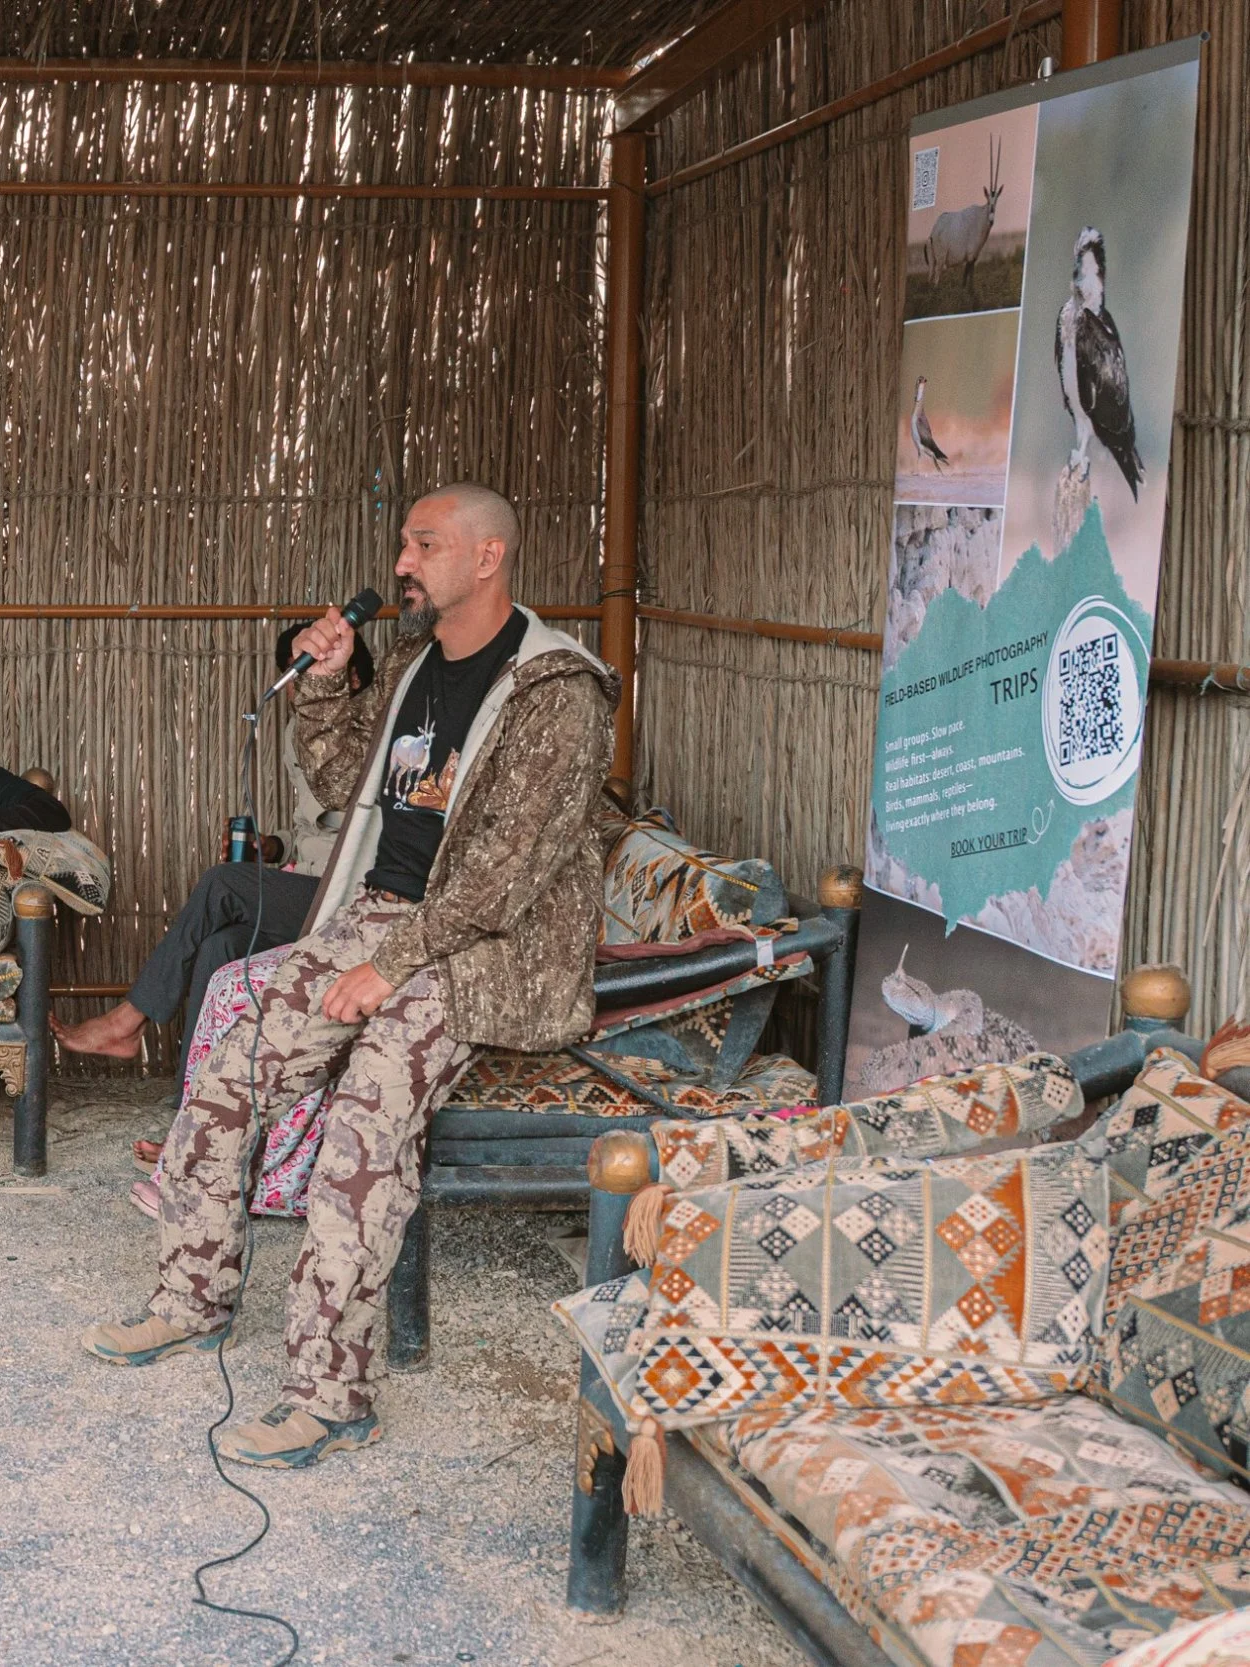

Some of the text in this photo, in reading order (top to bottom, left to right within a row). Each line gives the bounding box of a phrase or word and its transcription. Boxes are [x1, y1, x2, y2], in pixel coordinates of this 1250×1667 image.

[884, 630, 1049, 707] FIELD-BASED WILDLIFE PHOTOGRAPHY
[990, 667, 1038, 705] TRIPS
[885, 736, 903, 754] Small
[931, 726, 947, 740] Slow
[885, 777, 899, 793] Real
[955, 757, 977, 773] coast,
[978, 746, 1026, 767] mountains.
[904, 811, 930, 827] exactly
[930, 808, 950, 822] where
[950, 803, 966, 817] they
[966, 797, 998, 813] belong.
[950, 827, 1028, 856] BOOK YOUR TRIP
